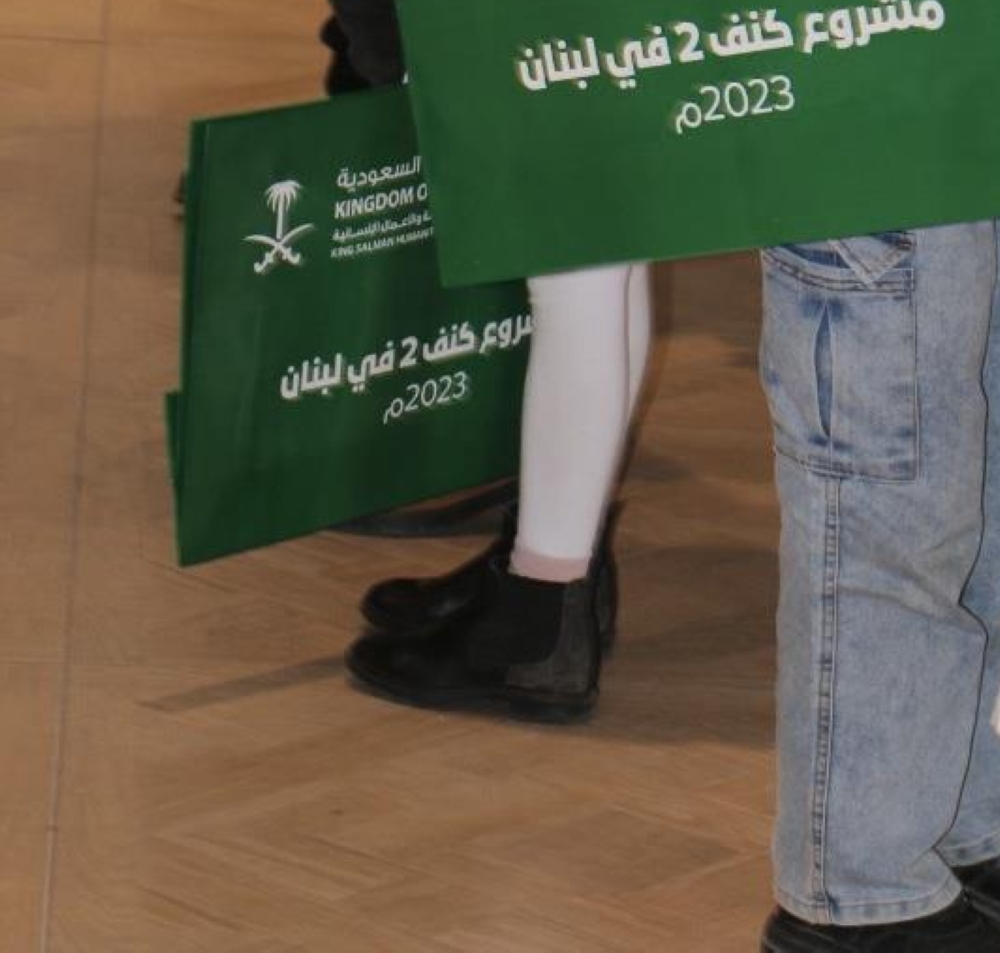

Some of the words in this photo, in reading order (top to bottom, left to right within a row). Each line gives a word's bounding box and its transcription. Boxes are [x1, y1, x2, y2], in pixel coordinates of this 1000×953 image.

[673, 21, 704, 63] 2
[707, 8, 794, 58] كنف
[516, 35, 600, 91] لبنان
[604, 25, 672, 89] في
[337, 155, 421, 193] السعودية
[334, 186, 414, 219] KINGDOM
[417, 183, 428, 202] O
[399, 336, 418, 369] 2
[423, 321, 475, 362] كنف
[279, 353, 342, 400] لبنان
[347, 341, 395, 393] في
